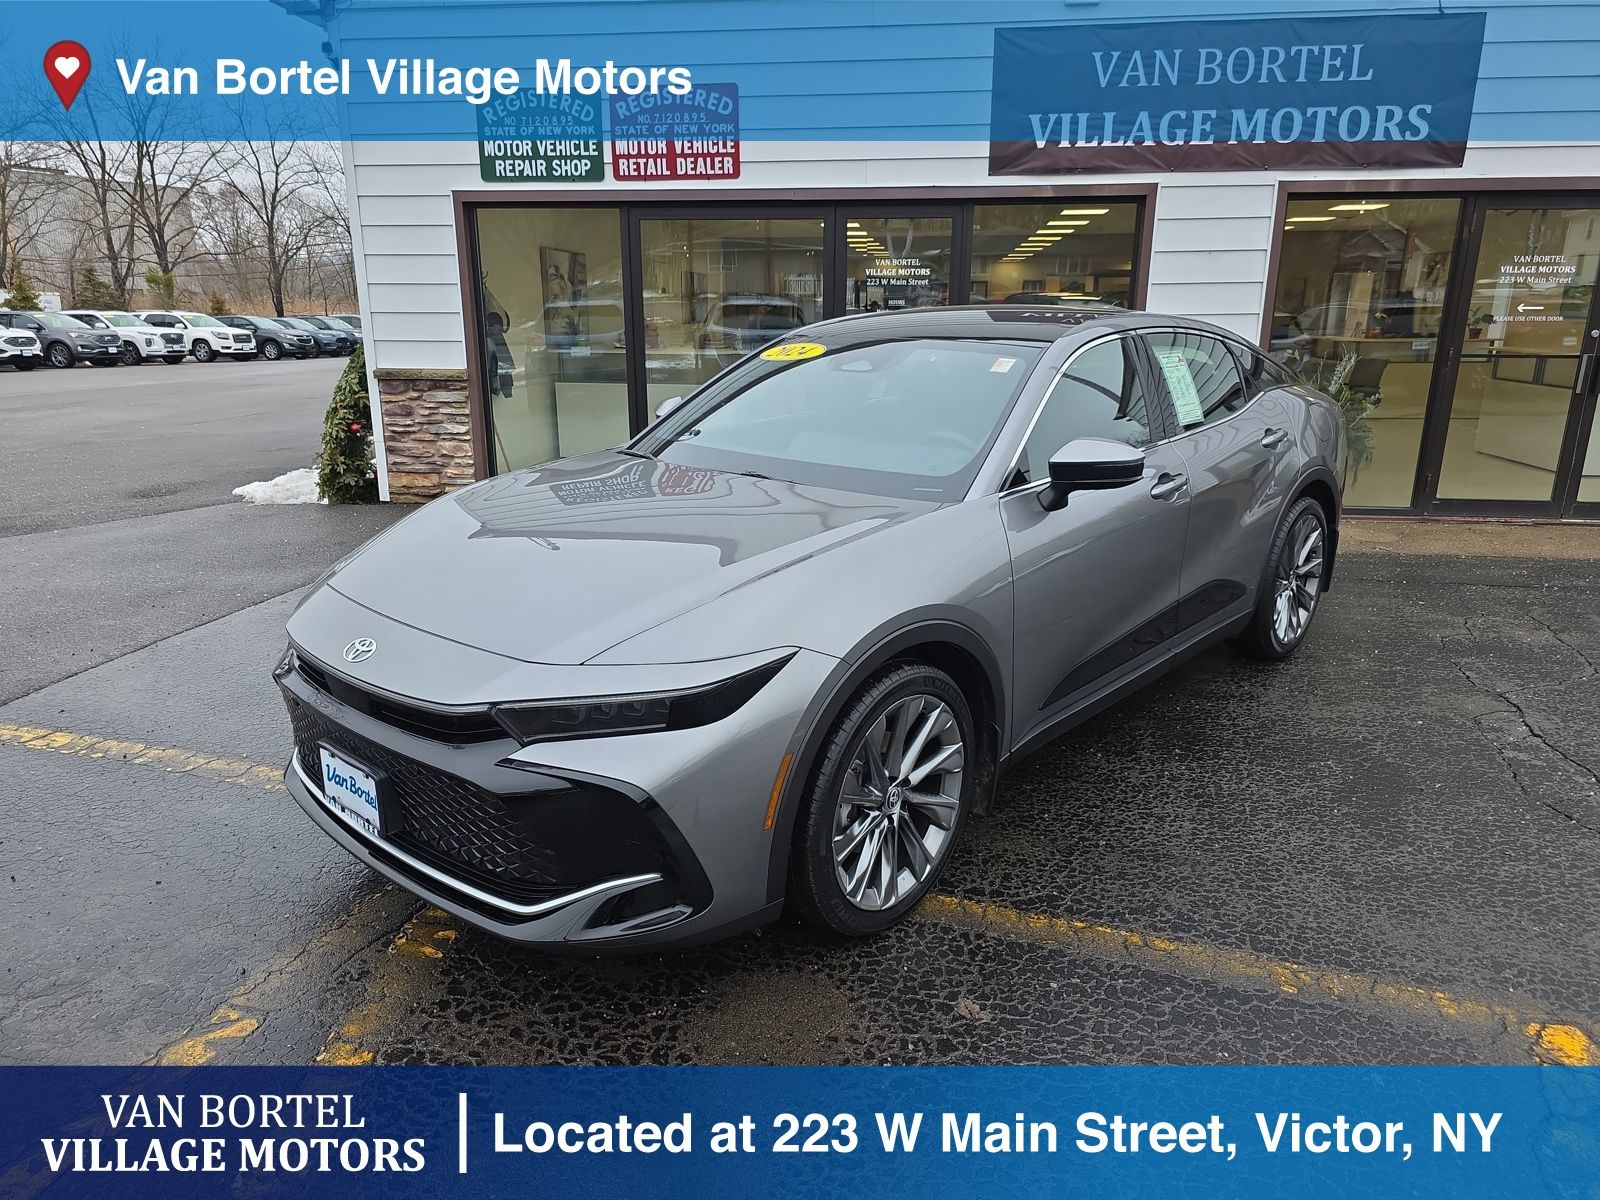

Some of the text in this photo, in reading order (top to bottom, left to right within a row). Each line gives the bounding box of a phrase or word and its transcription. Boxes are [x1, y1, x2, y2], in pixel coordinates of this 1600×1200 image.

[1092, 44, 1374, 88] VAN BORTEL
[482, 89, 595, 124] REGISTERED
[615, 88, 734, 120] REGISTERED
[521, 116, 574, 126] 7120895
[654, 112, 707, 123] 7120895
[484, 125, 596, 136] STATE OF NEW YORK
[614, 123, 735, 136] STATE OF NEW YORK
[1028, 104, 1433, 149] VILLAGE MOTORS
[484, 139, 598, 157] MOTOR VEHICLE
[615, 136, 736, 156] MOTOR VEHICLE
[495, 159, 591, 177] REPAIR SHOP
[619, 157, 734, 176] RETAIL DEALER
[875, 258, 921, 266] VAN BORTEL
[1513, 255, 1567, 263] VAN BORTEL
[865, 268, 931, 276] VILLAGE MOTORS
[1500, 266, 1576, 274] VILLAGE MOTORS
[866, 278, 929, 286] 223 W Main Street
[1499, 276, 1572, 284] 223 W Main Street
